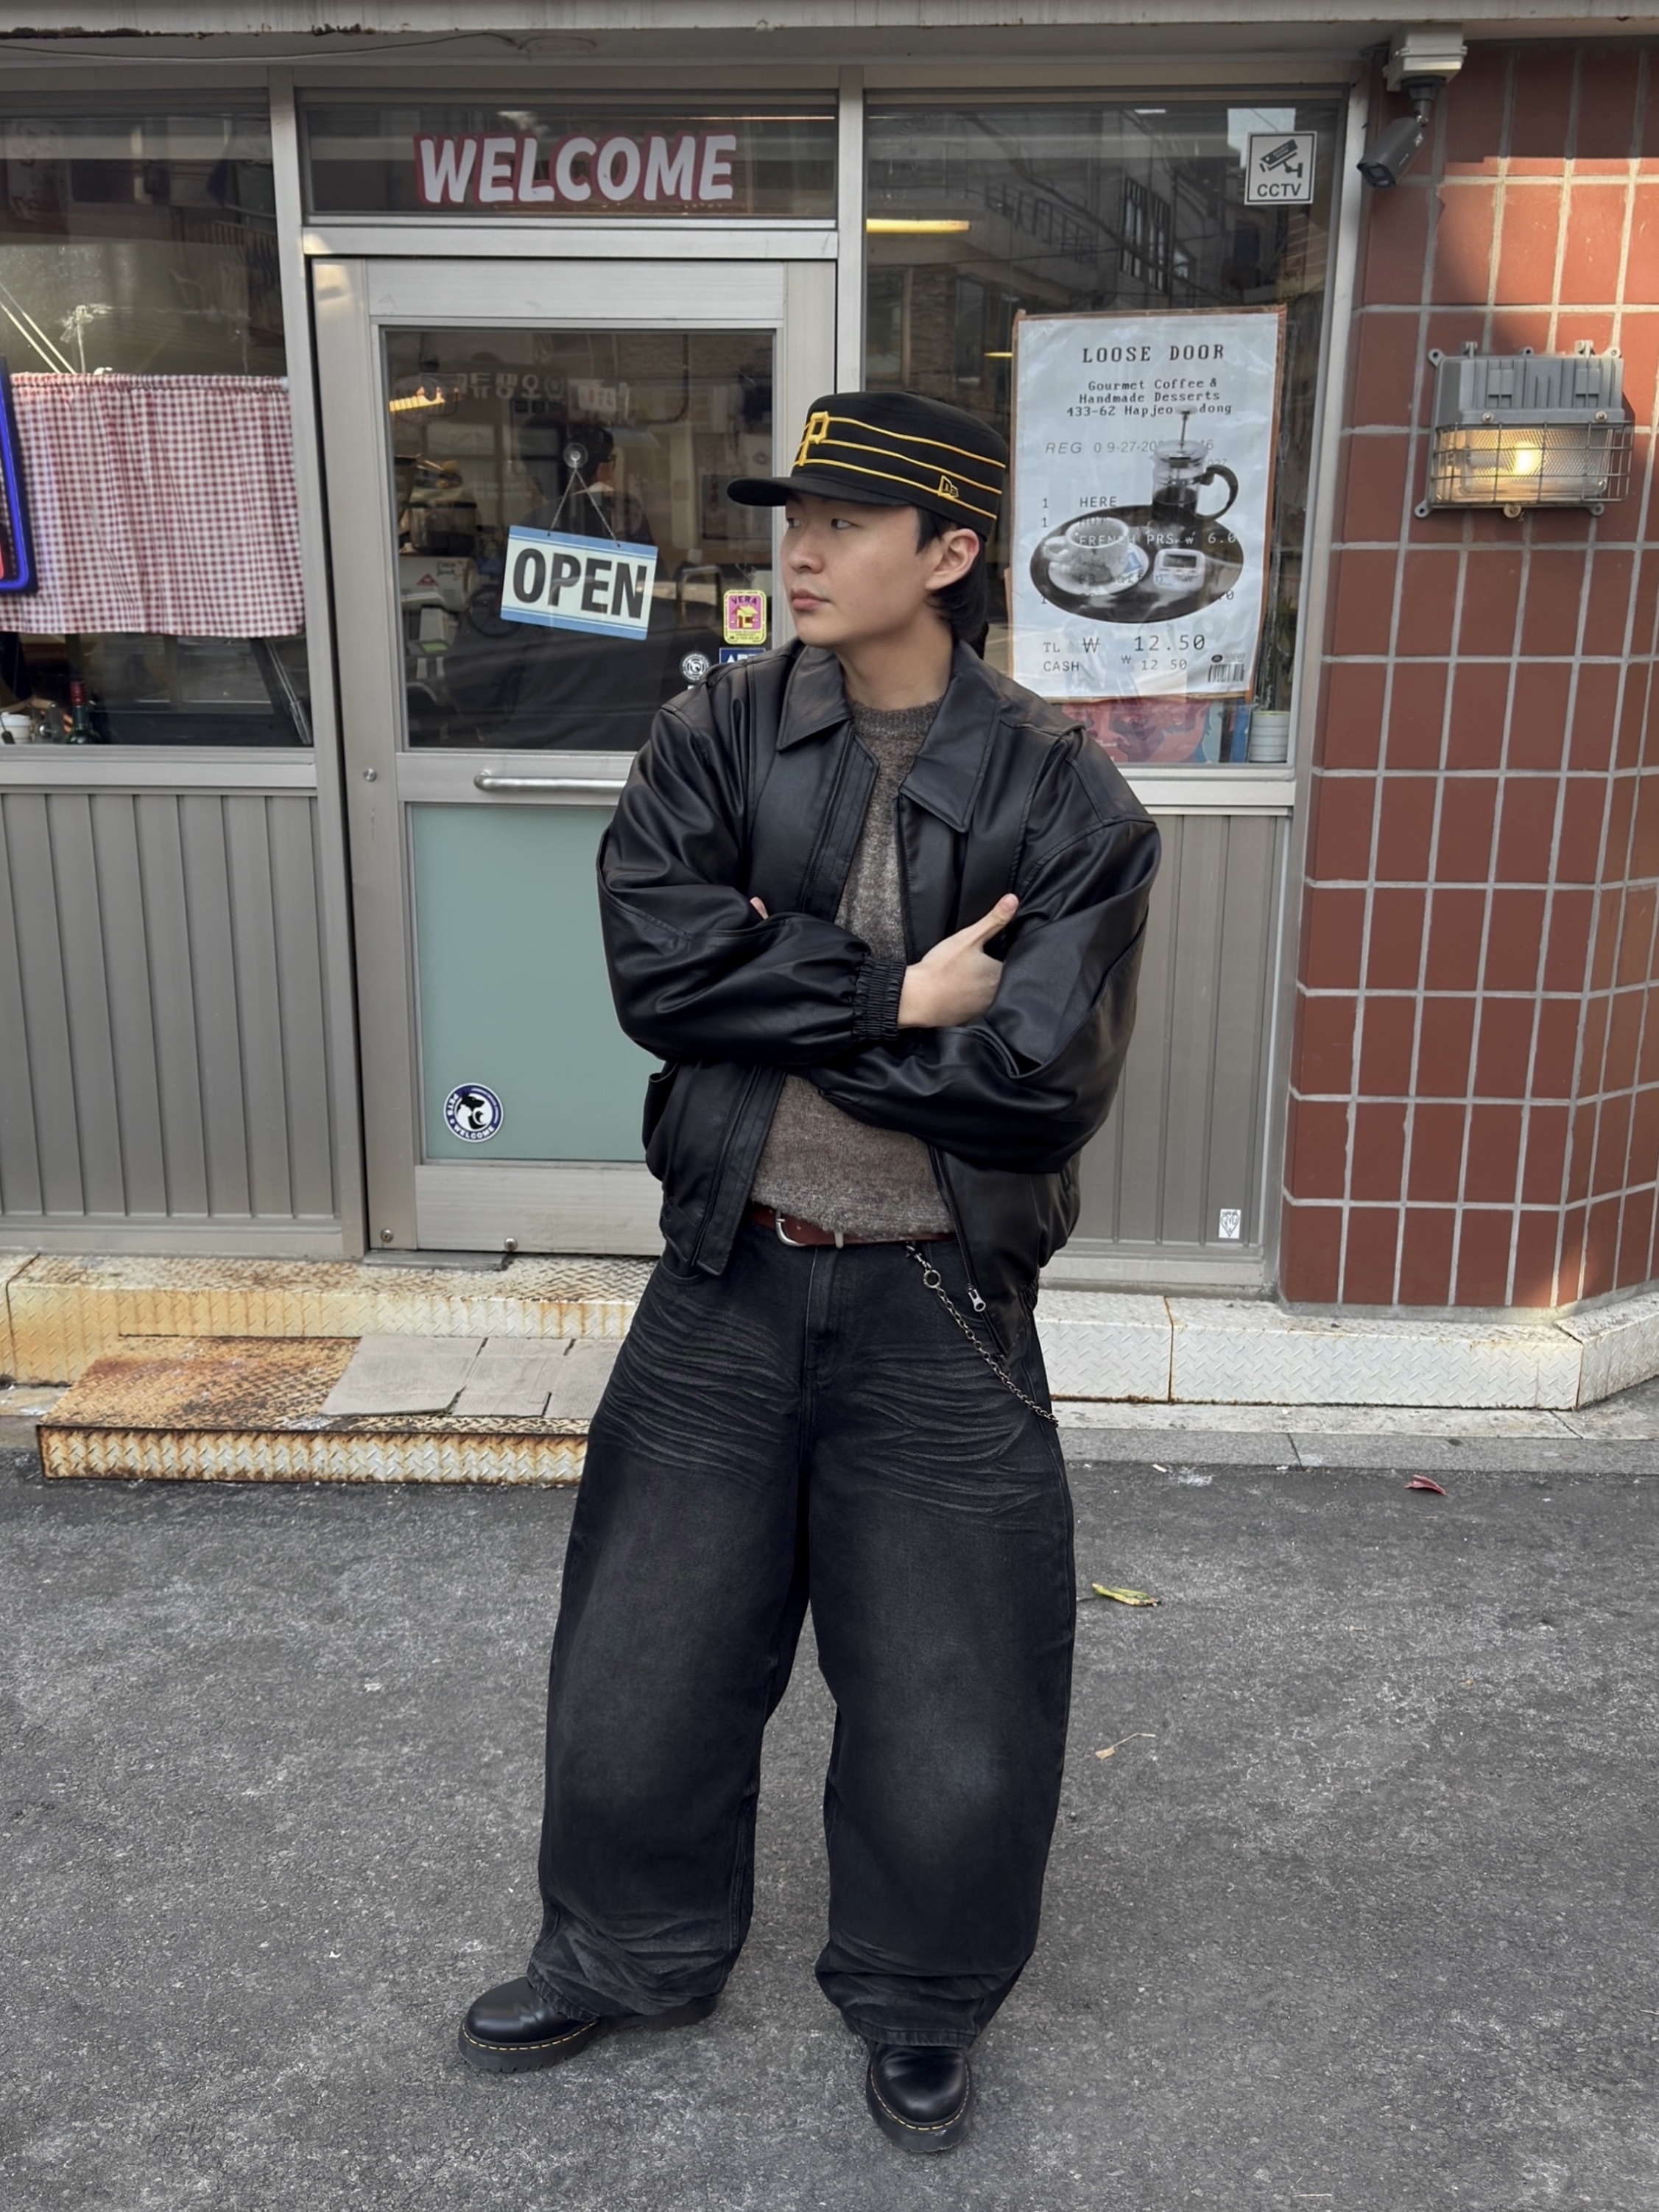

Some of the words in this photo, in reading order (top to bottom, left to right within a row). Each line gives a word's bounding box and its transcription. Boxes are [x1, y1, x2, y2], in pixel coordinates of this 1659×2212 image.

[415, 131, 736, 205] WELCOME
[1257, 183, 1301, 197] CCTV
[1082, 346, 1151, 363] LOOSE
[1169, 344, 1224, 361] DOOR
[1088, 380, 1145, 391] Gourmet
[1154, 378, 1204, 390] Coffee
[1210, 377, 1217, 388] &
[1079, 392, 1145, 404] Handmade
[1154, 390, 1220, 402] Desserts
[1067, 406, 1116, 417] 433-62
[1046, 442, 1082, 454] REG
[1042, 498, 1049, 508] 1
[1079, 496, 1117, 507] HERE
[1042, 517, 1048, 527] 1
[513, 548, 647, 619] OPEN
[731, 595, 757, 605] VERA
[1043, 642, 1060, 652] TL
[1135, 634, 1205, 652] 12.50
[1044, 661, 1079, 672] CASH
[454, 1124, 495, 1139] WELCOME
